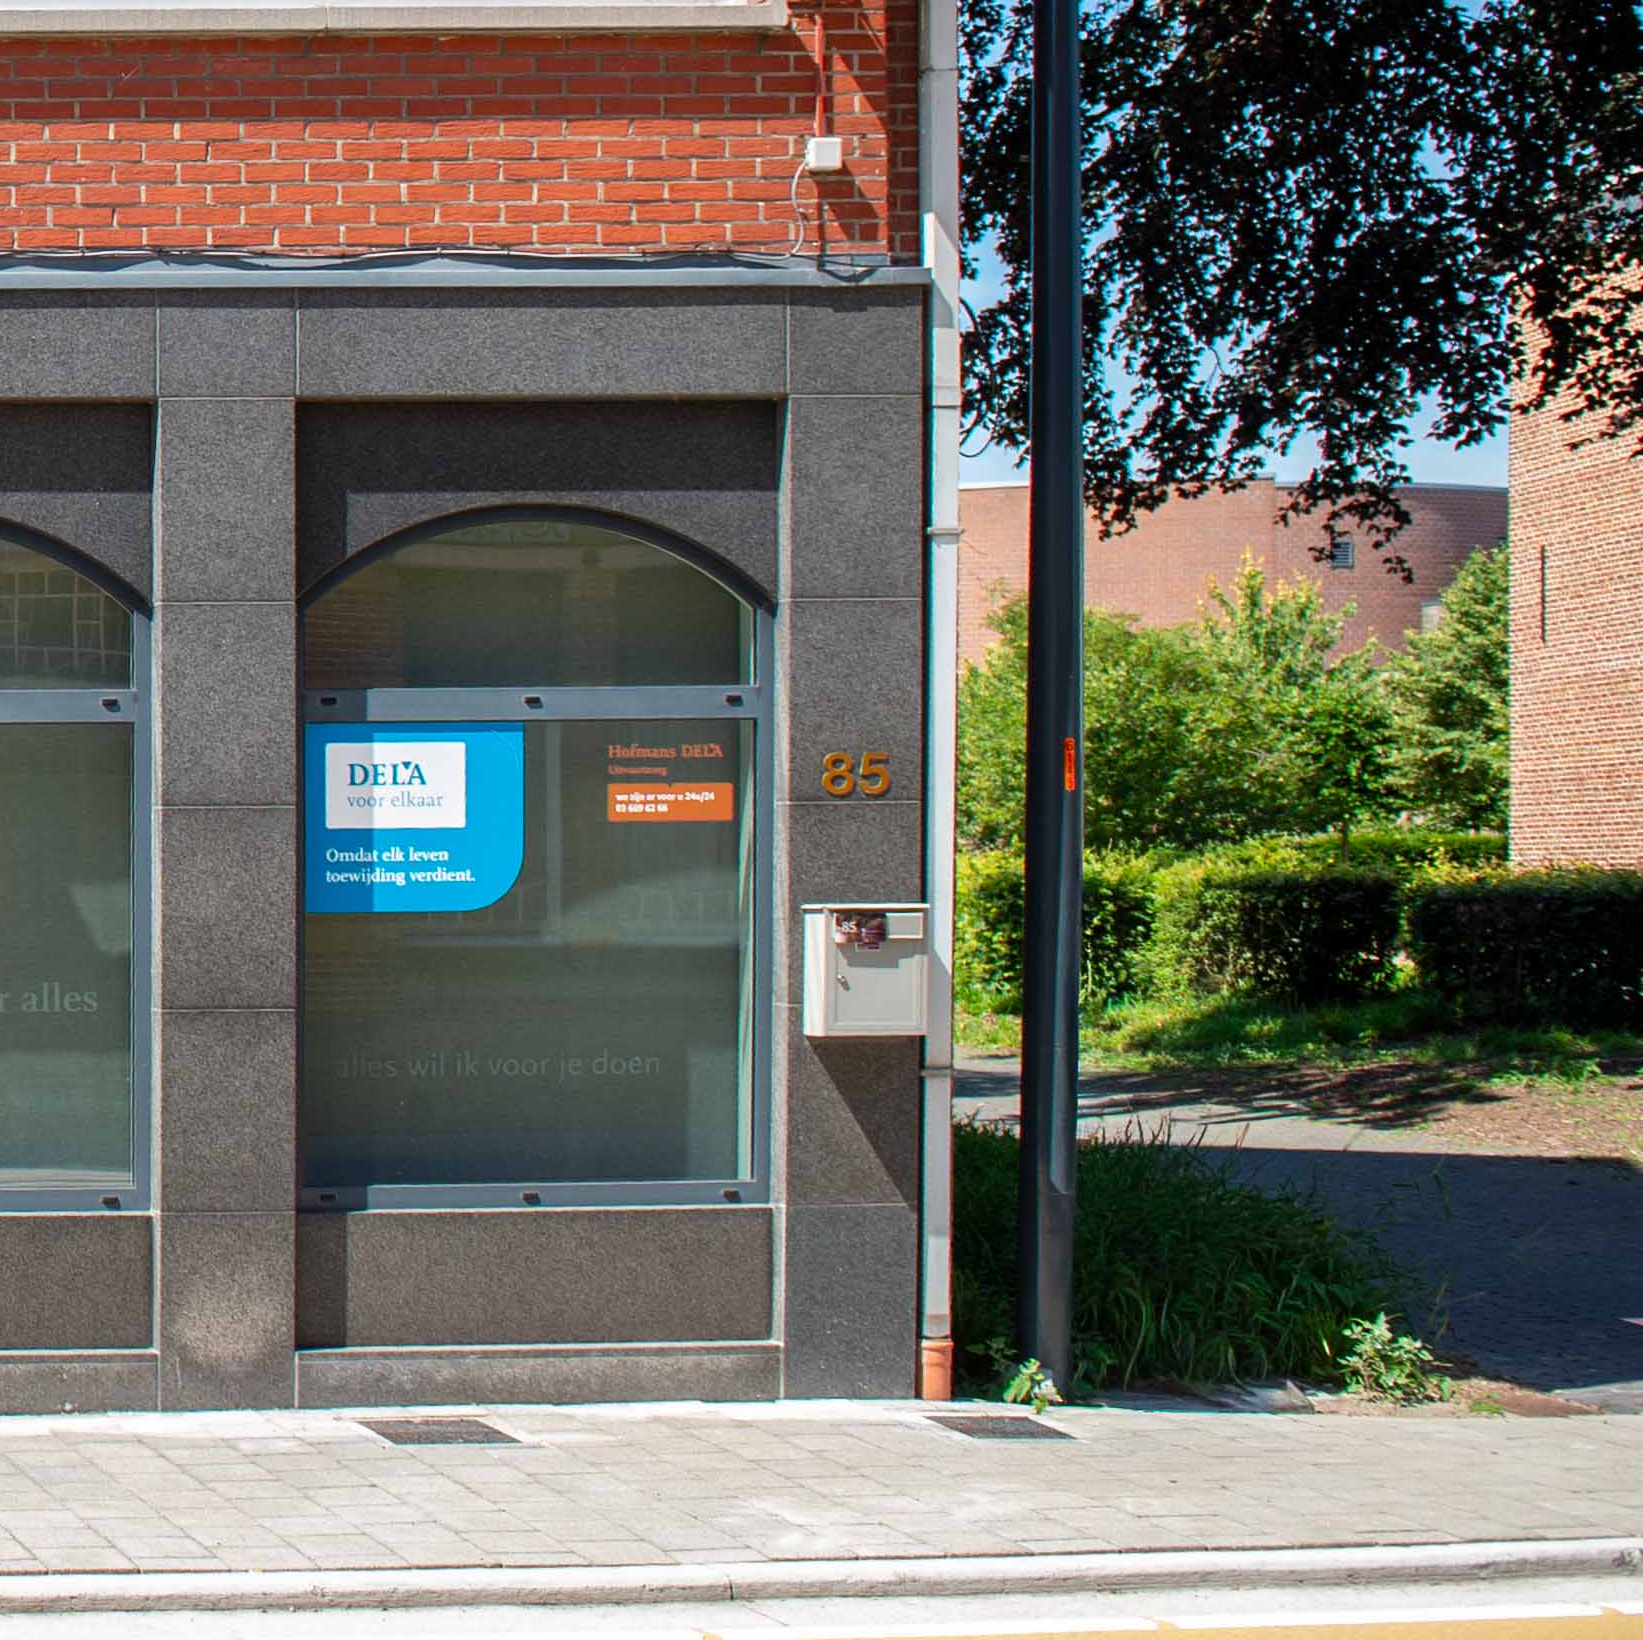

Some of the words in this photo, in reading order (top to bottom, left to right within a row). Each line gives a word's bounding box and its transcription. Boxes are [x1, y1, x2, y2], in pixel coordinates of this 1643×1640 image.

[608, 744, 678, 759] Hofmans
[681, 744, 724, 759] DELA
[347, 761, 427, 786] DELA
[821, 751, 891, 796] 85
[347, 794, 383, 808] voor
[390, 791, 443, 808] elkaar
[326, 847, 378, 862] Omdat
[381, 846, 405, 862] elk
[409, 846, 449, 862] leven
[326, 867, 405, 886] toewijding
[409, 867, 475, 882] verdient.
[20, 981, 98, 1015] alles
[488, 1055, 551, 1077] voor
[592, 1048, 660, 1076] doen
